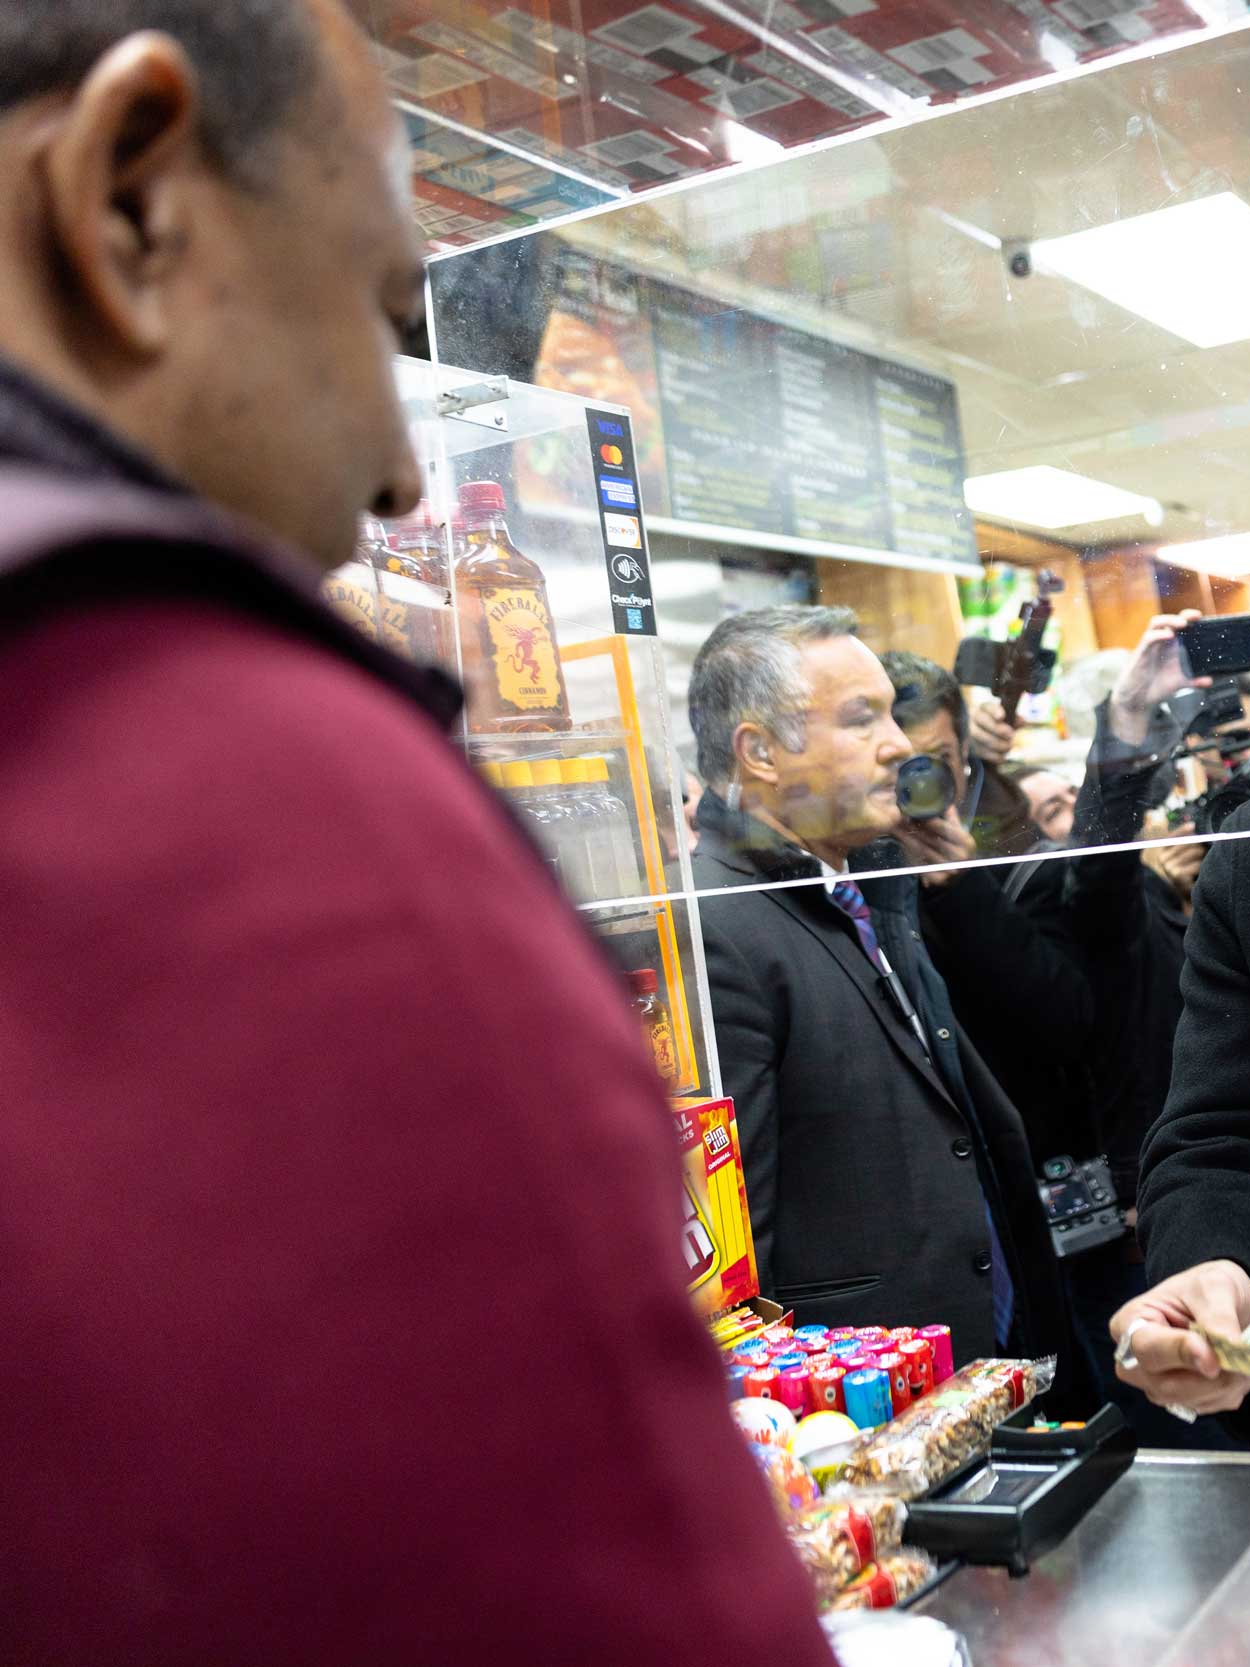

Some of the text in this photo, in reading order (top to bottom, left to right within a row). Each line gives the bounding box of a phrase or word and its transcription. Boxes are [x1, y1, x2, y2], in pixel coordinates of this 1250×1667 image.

[596, 419, 624, 436] VISA
[490, 597, 547, 624] FIREBALL
[708, 1152, 731, 1170] ORIGINAL
